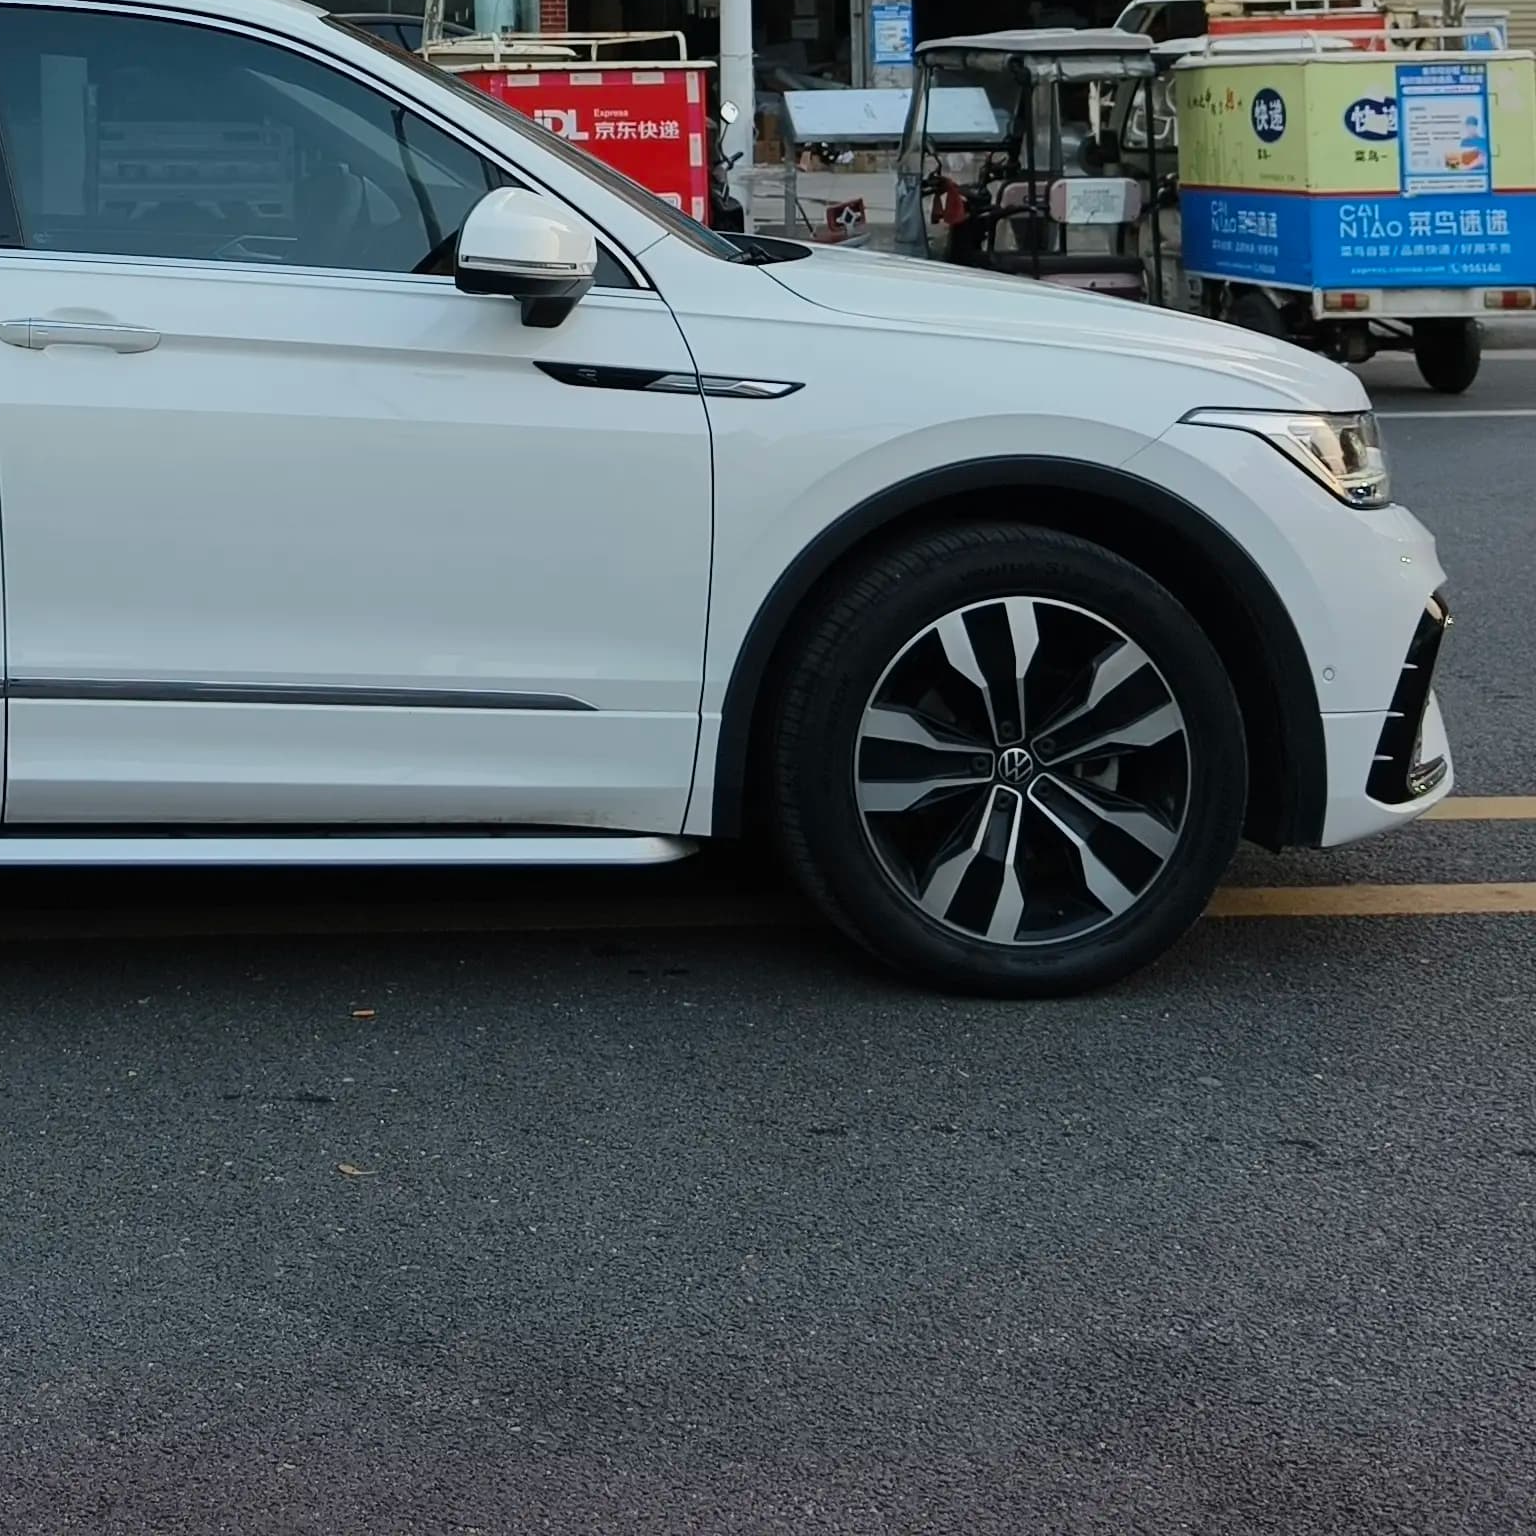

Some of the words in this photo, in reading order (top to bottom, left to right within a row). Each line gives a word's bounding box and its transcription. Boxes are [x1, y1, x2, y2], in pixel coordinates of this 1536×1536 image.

[594, 120, 680, 140] 京东快递
[1408, 208, 1511, 236] 菜鸟速递
